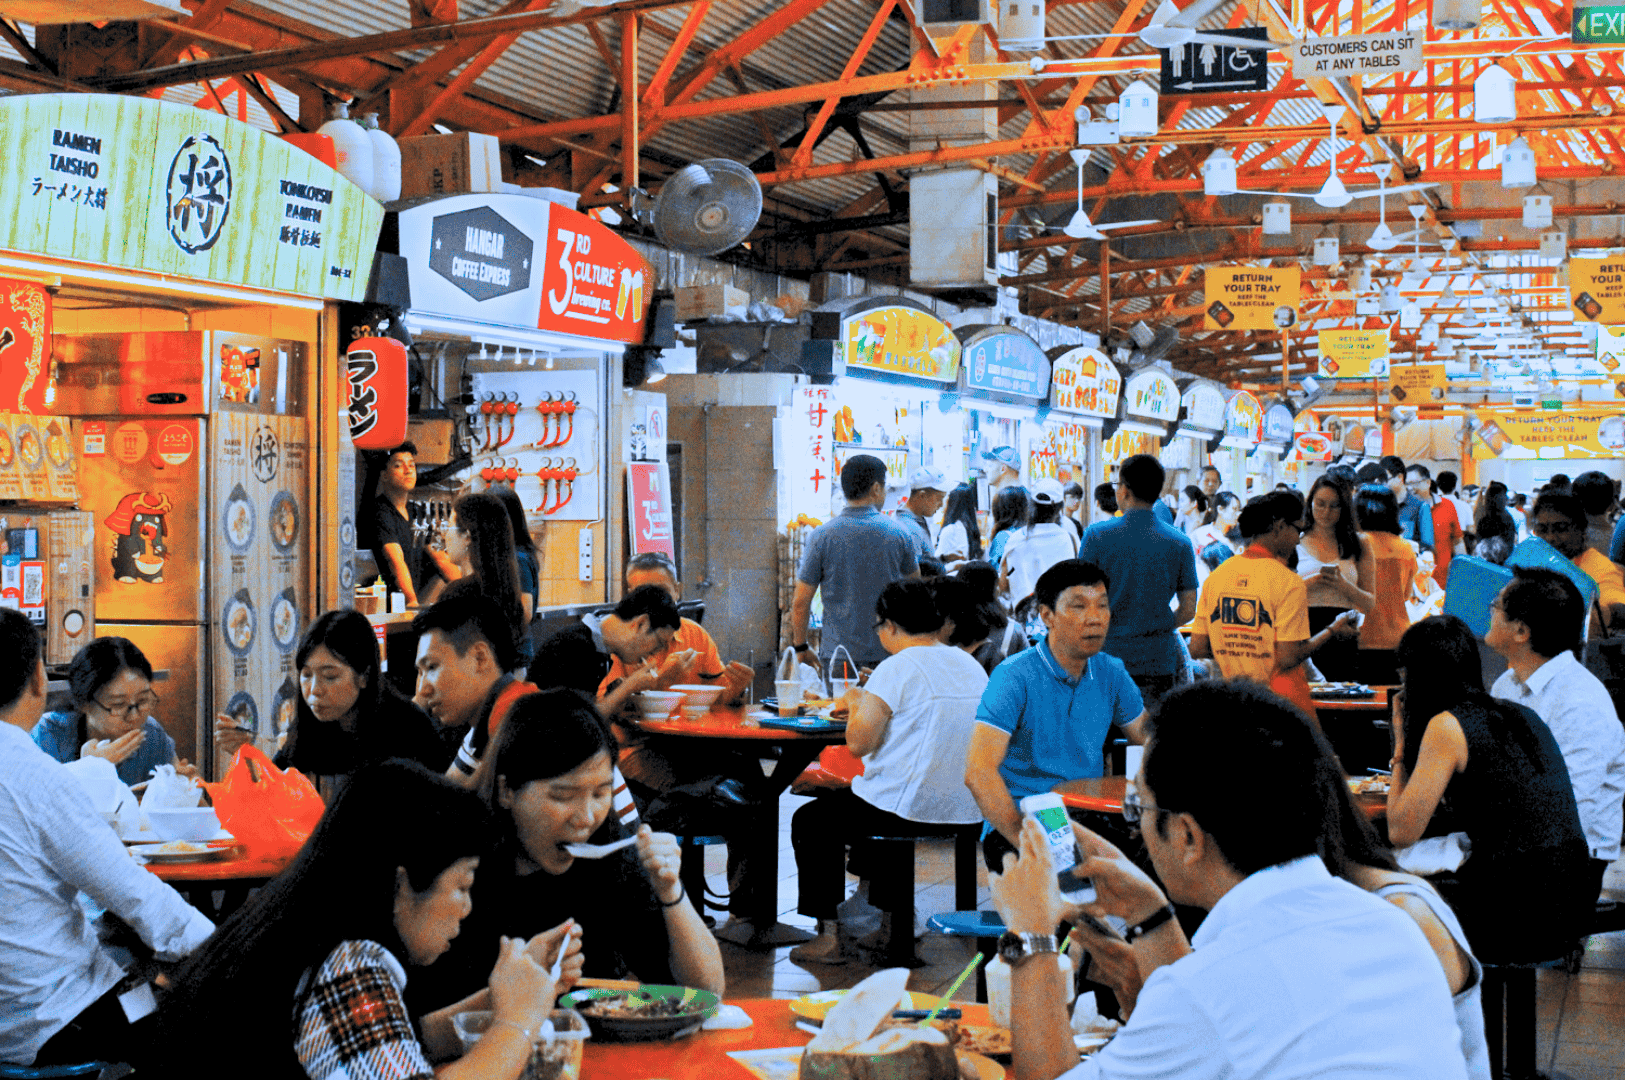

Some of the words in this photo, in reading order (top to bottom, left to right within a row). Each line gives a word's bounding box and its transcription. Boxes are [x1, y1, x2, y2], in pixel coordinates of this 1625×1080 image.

[1300, 41, 1368, 56] CUSTOMERS
[1371, 39, 1395, 52] CAN
[1397, 37, 1415, 50] SIT
[1316, 60, 1329, 71] AT
[1332, 58, 1355, 70] ANY
[1359, 55, 1400, 68] TABLES
[53, 129, 102, 155] RAMEN
[49, 153, 99, 179] TAISHO
[286, 203, 322, 223] RAMEN
[465, 226, 505, 259] HANGAR
[452, 256, 480, 281] COFFEE
[479, 262, 511, 287] EXPRESS
[574, 261, 616, 288] CULTURE
[1232, 274, 1273, 282] RETURN
[1590, 275, 1622, 284] YOUR
[1223, 284, 1252, 293] YOUR
[1254, 284, 1281, 293] TRAY
[1505, 416, 1545, 424] RETURN
[1547, 416, 1575, 424] YOUR
